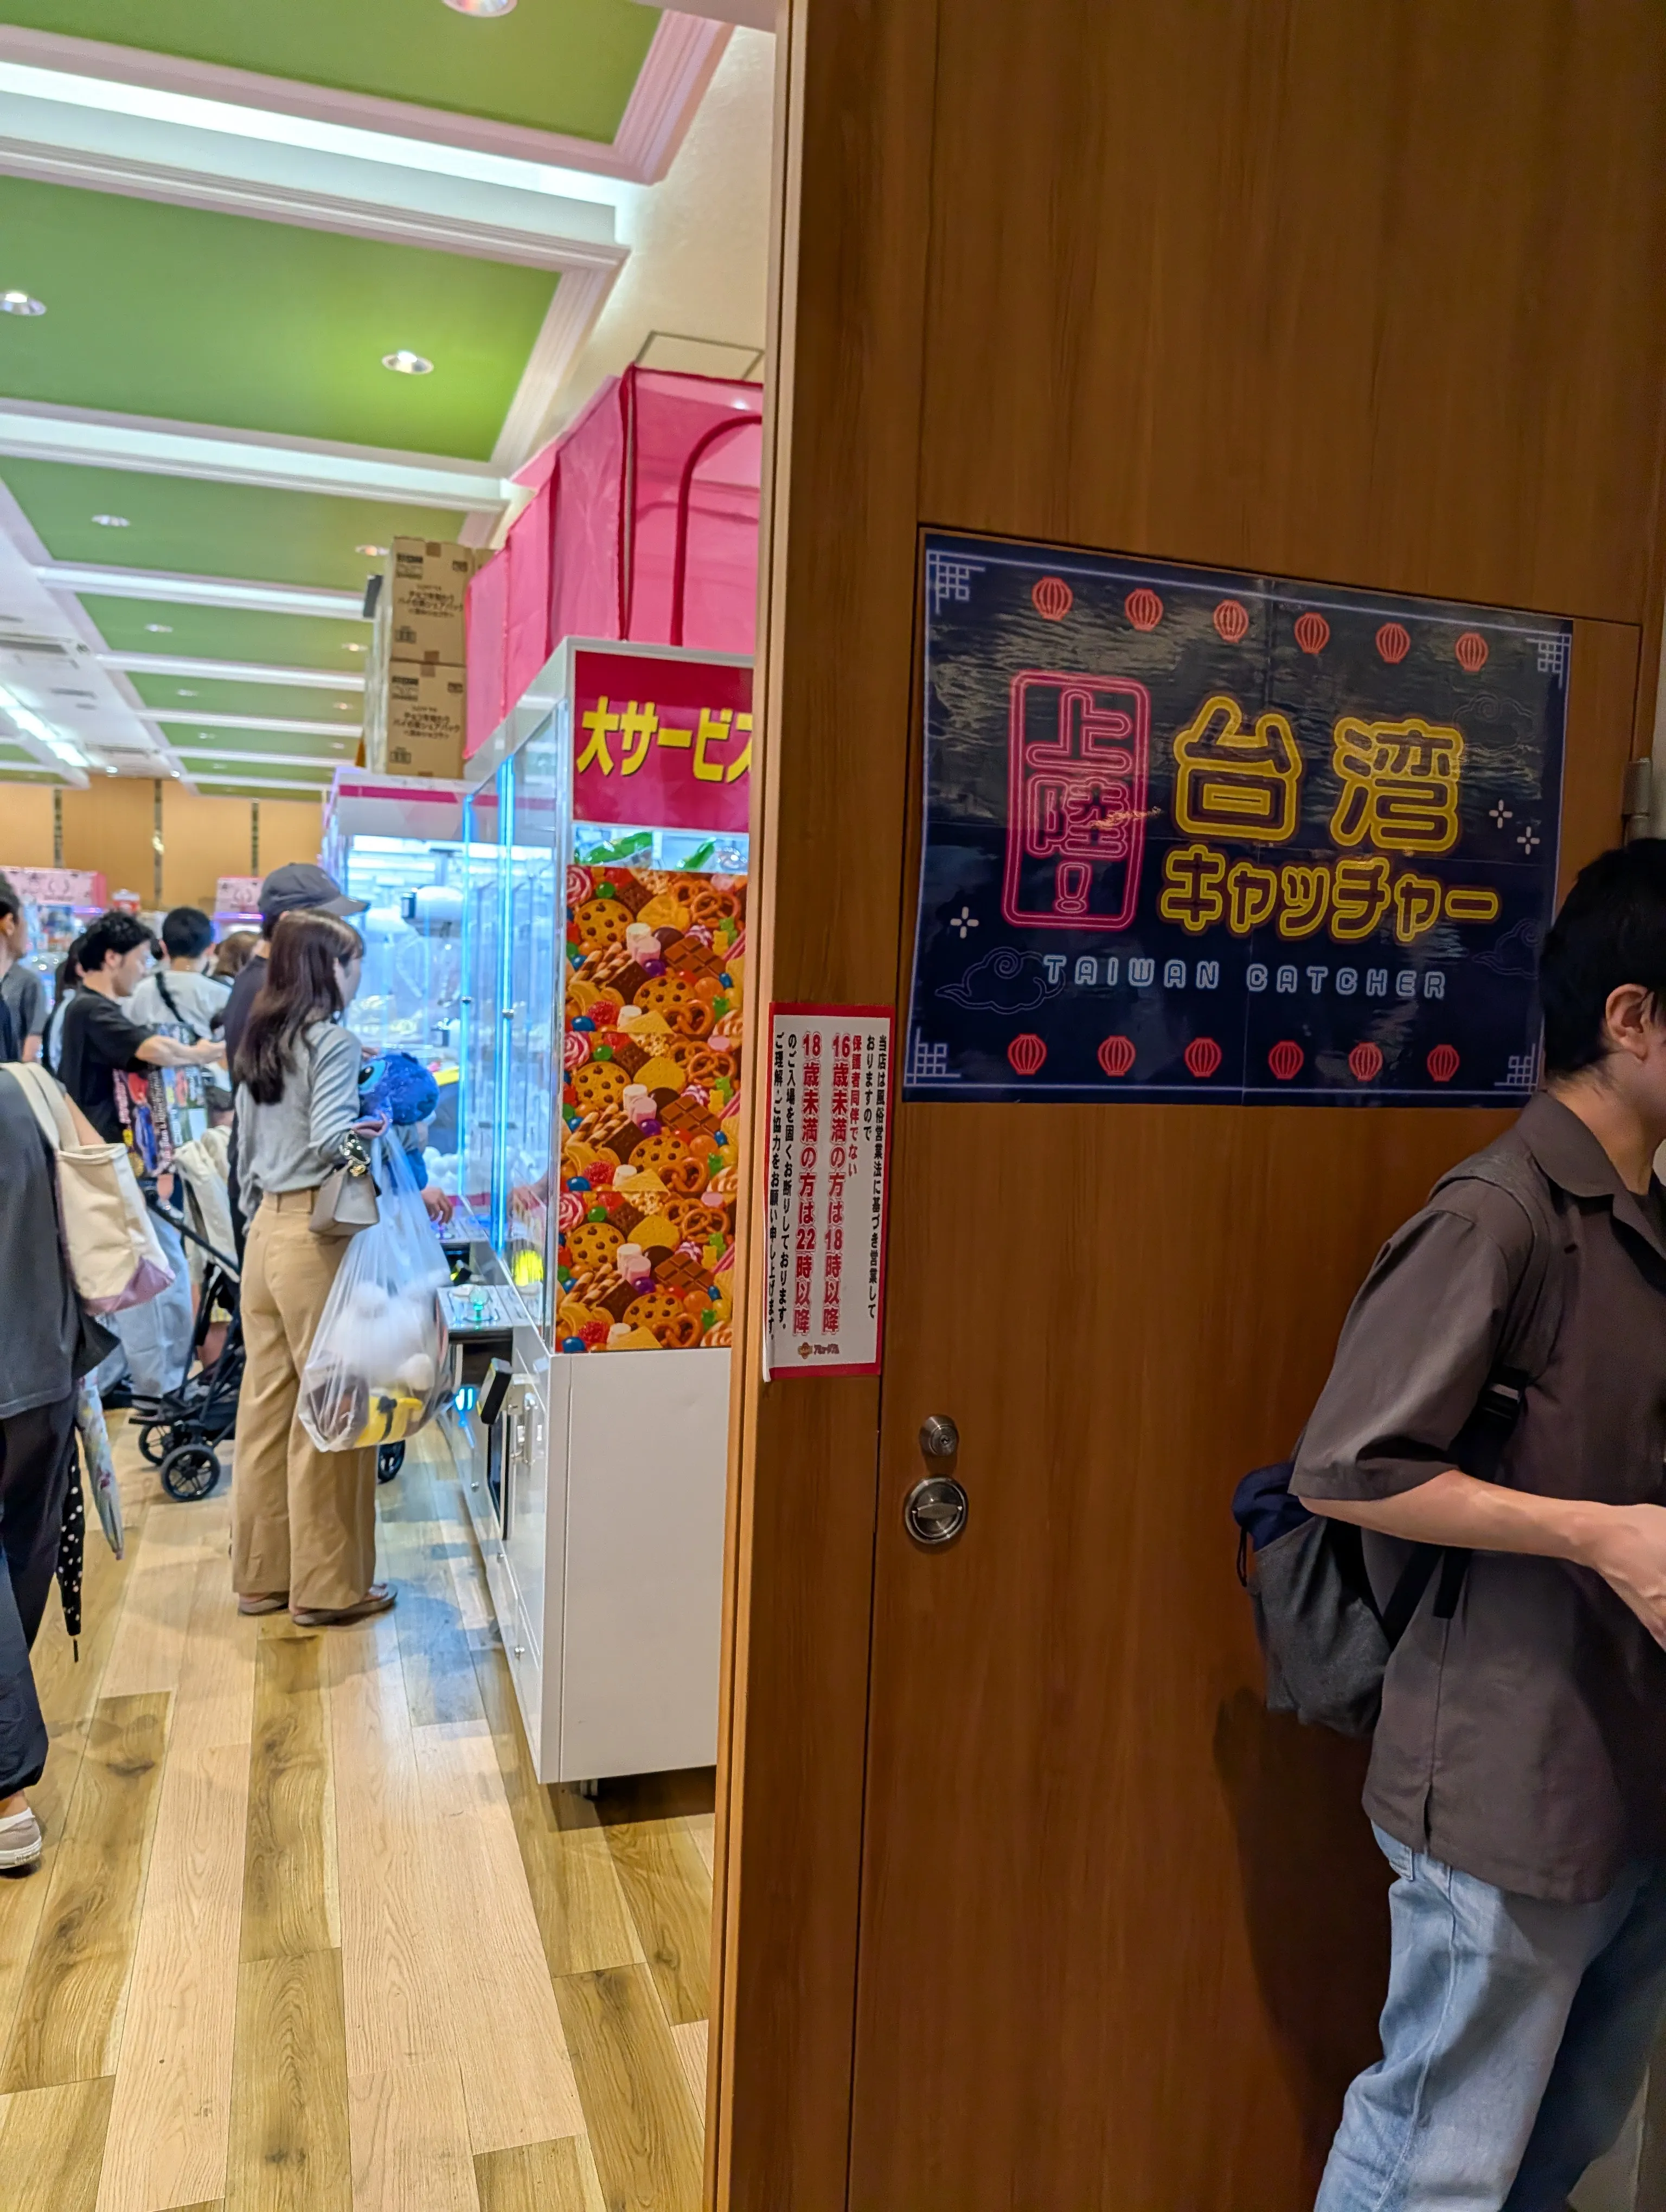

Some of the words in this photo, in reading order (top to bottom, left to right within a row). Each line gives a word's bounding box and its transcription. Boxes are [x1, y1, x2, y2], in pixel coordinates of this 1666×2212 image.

[1175, 696, 1463, 852] 台湾
[1161, 845, 1498, 941] キャッチャー
[1043, 955, 1219, 989] TAIWAN
[1246, 963, 1446, 999] CATCHER
[848, 1035, 862, 1176] 保護者同伴でない
[863, 1035, 875, 1141] おりますので
[794, 1032, 821, 1334] 18歳未満の方は22時以降
[822, 1032, 850, 1334] 16歳未満の方は18時以降
